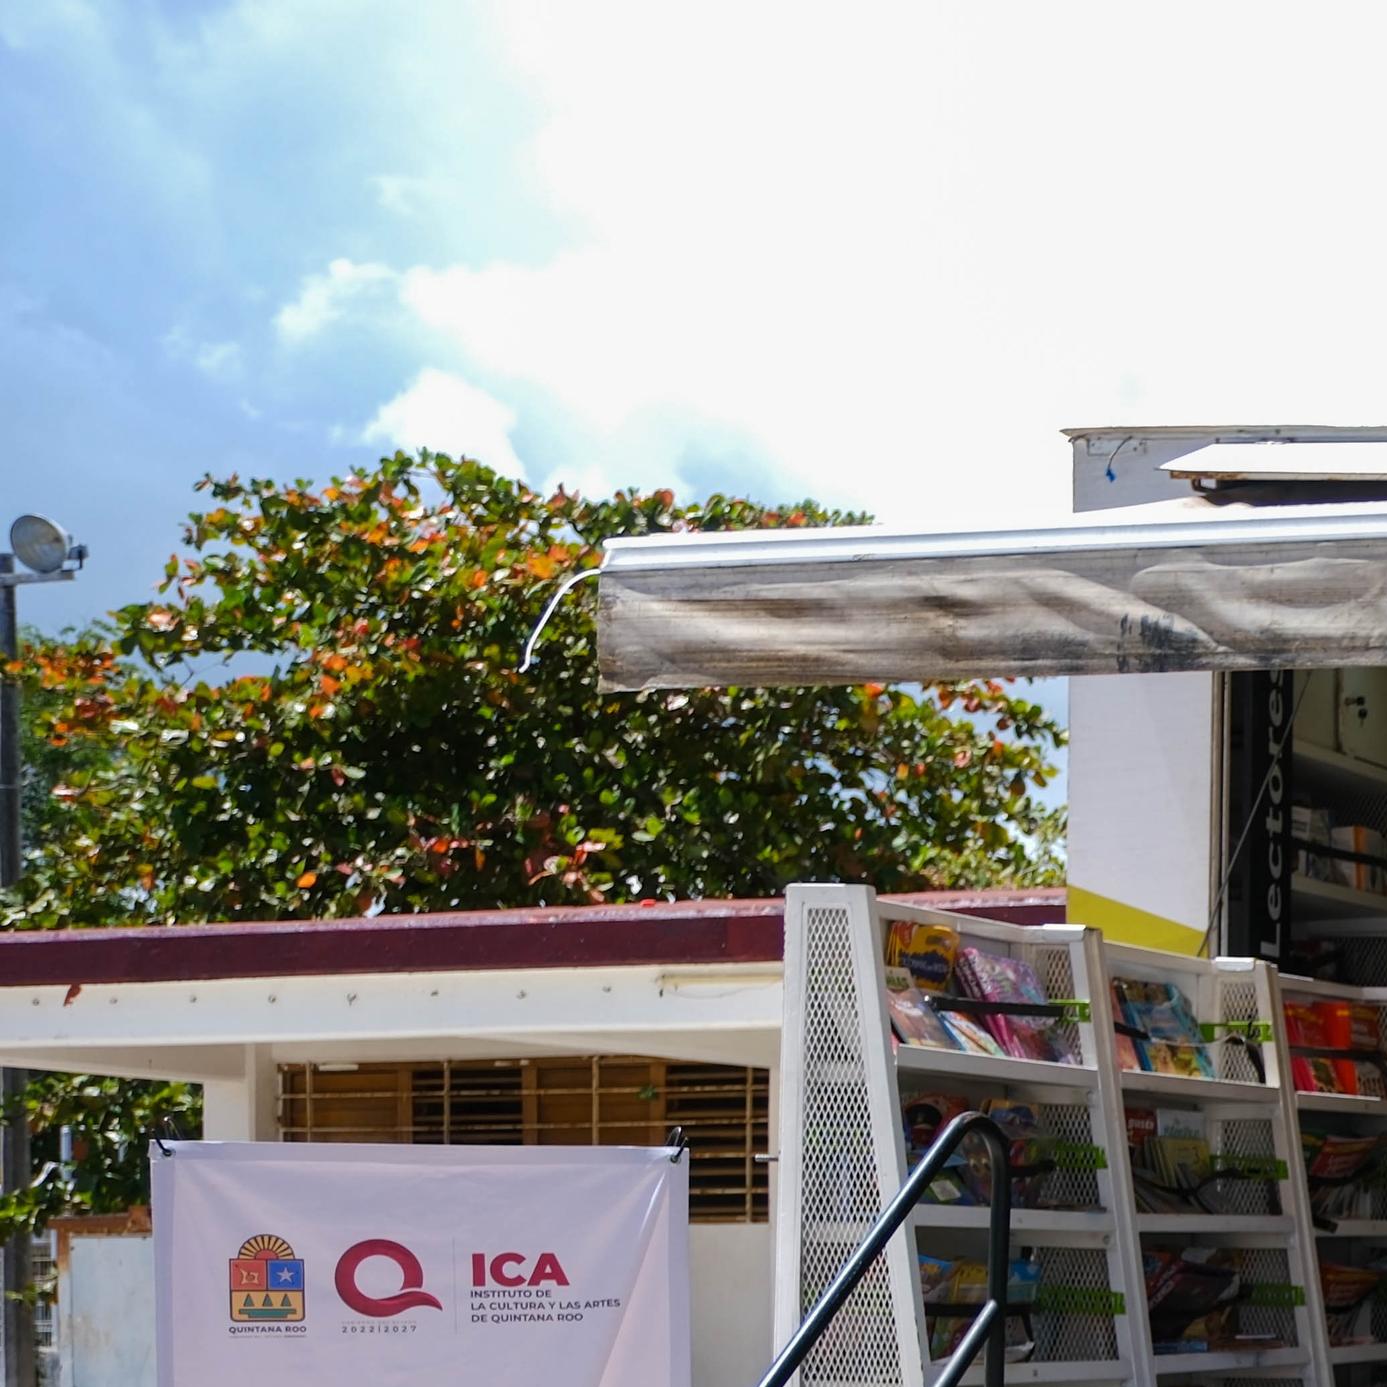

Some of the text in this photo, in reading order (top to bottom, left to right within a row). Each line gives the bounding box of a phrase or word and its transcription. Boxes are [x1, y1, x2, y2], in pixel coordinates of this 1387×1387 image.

[471, 1252, 570, 1287] ICA
[470, 1289, 552, 1299] INSTITUTO DE
[471, 1299, 621, 1311] LA CULTURA Y LAS ARTES
[471, 1313, 584, 1324] DE QUINTANA ROO
[228, 1325, 307, 1334] QUINTANA ROO
